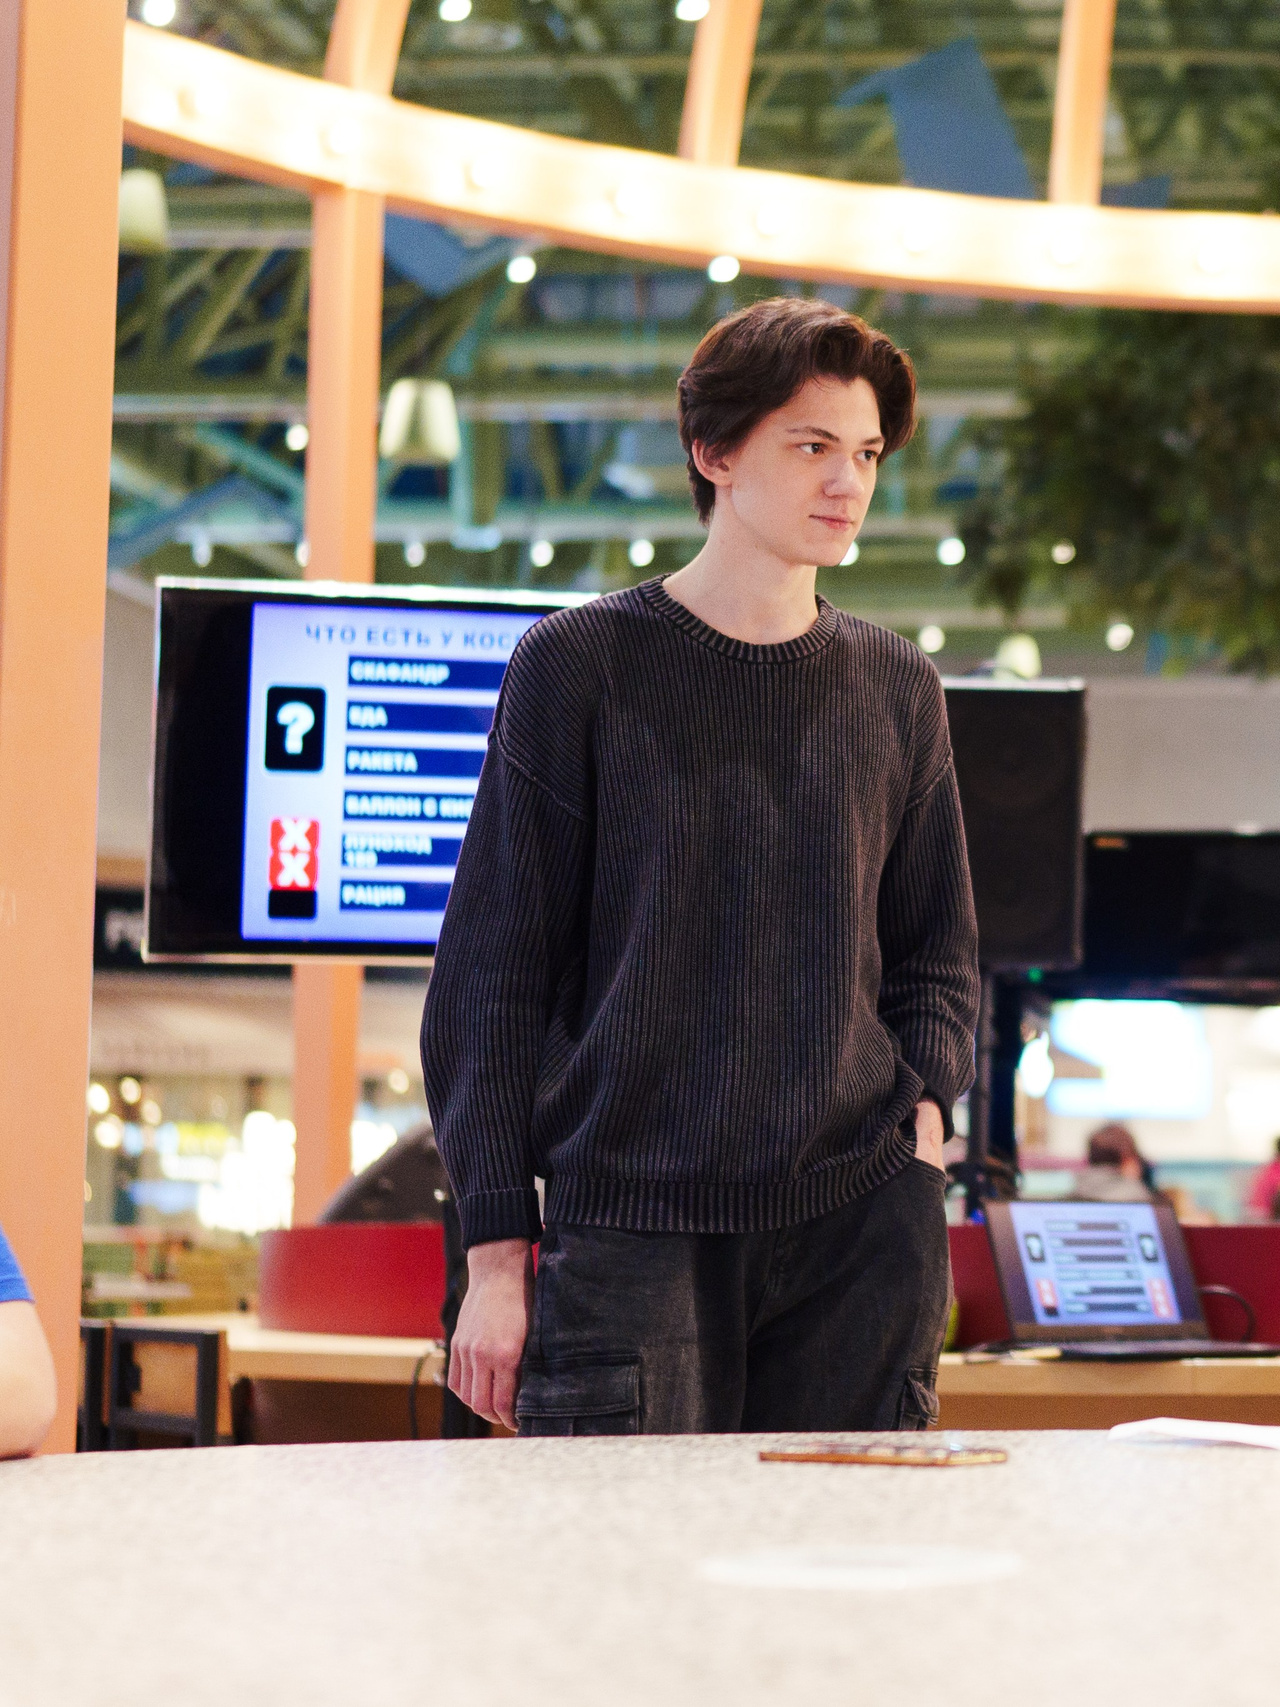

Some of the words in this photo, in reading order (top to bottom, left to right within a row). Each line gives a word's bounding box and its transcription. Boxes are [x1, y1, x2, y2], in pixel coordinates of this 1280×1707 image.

[305, 623, 356, 645] ЧТО
[366, 626, 431, 649] ЕСТЬ
[441, 629, 455, 649] У
[351, 662, 449, 684] СКАФАНДР
[349, 706, 388, 727] ЕДА
[347, 751, 418, 772] РАКЕТА
[346, 796, 422, 816] БАЛЛОН
[343, 885, 405, 906] РАЦИЯ
